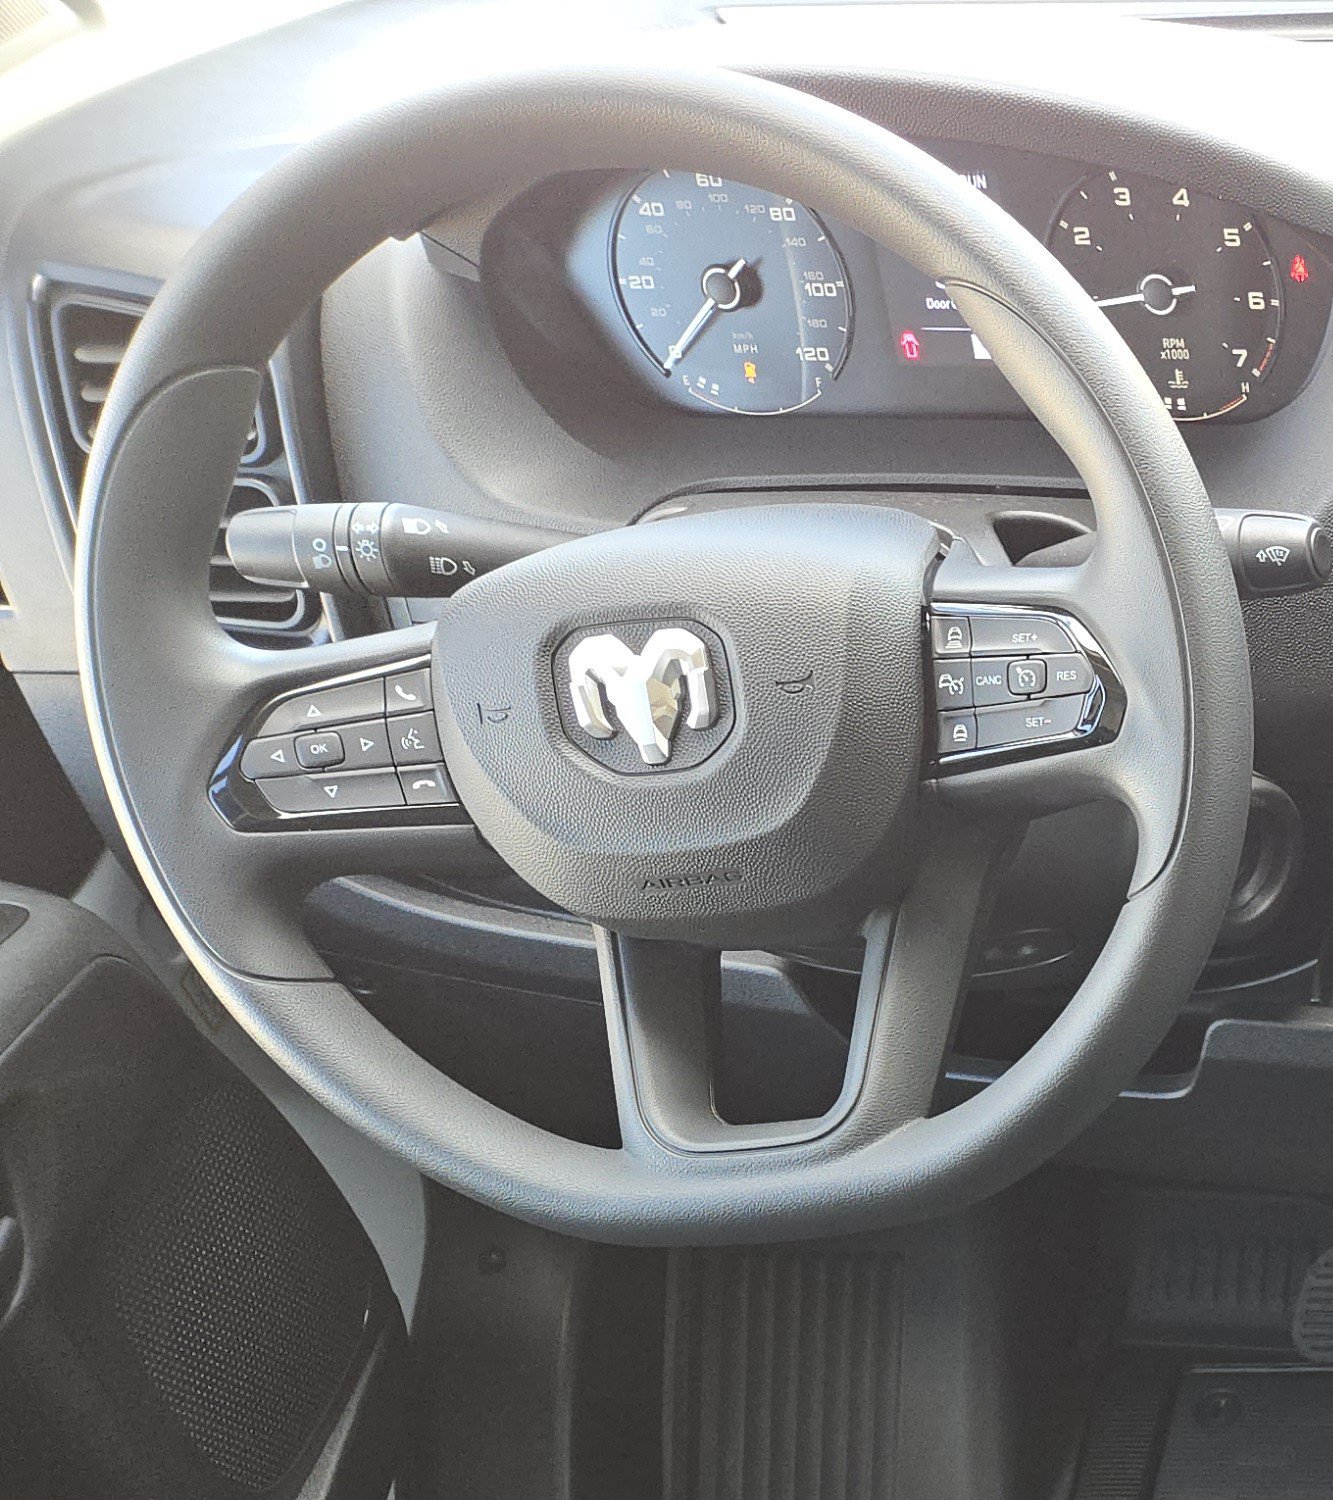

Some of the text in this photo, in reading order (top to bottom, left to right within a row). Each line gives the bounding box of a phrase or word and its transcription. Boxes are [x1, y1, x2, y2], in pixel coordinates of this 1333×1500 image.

[1114, 187, 1131, 207] 3
[1172, 187, 1189, 207] 4
[639, 202, 665, 217] 40
[769, 207, 796, 221] 80
[1074, 227, 1091, 245] 2
[1223, 228, 1241, 246] 5
[628, 275, 654, 290] 20
[804, 283, 837, 297] 100
[1247, 292, 1265, 311] 6
[733, 344, 758, 354] MPH
[1162, 337, 1185, 350] RPM
[795, 347, 830, 361] 120
[1160, 349, 1190, 361] x1000
[1232, 349, 1248, 368] 7
[682, 374, 691, 386] E
[815, 377, 822, 388] F
[1240, 382, 1250, 394] H
[975, 674, 1002, 686] CANC
[1056, 670, 1077, 682] RES
[310, 743, 328, 755] OK
[642, 872, 742, 890] AIRBAG
